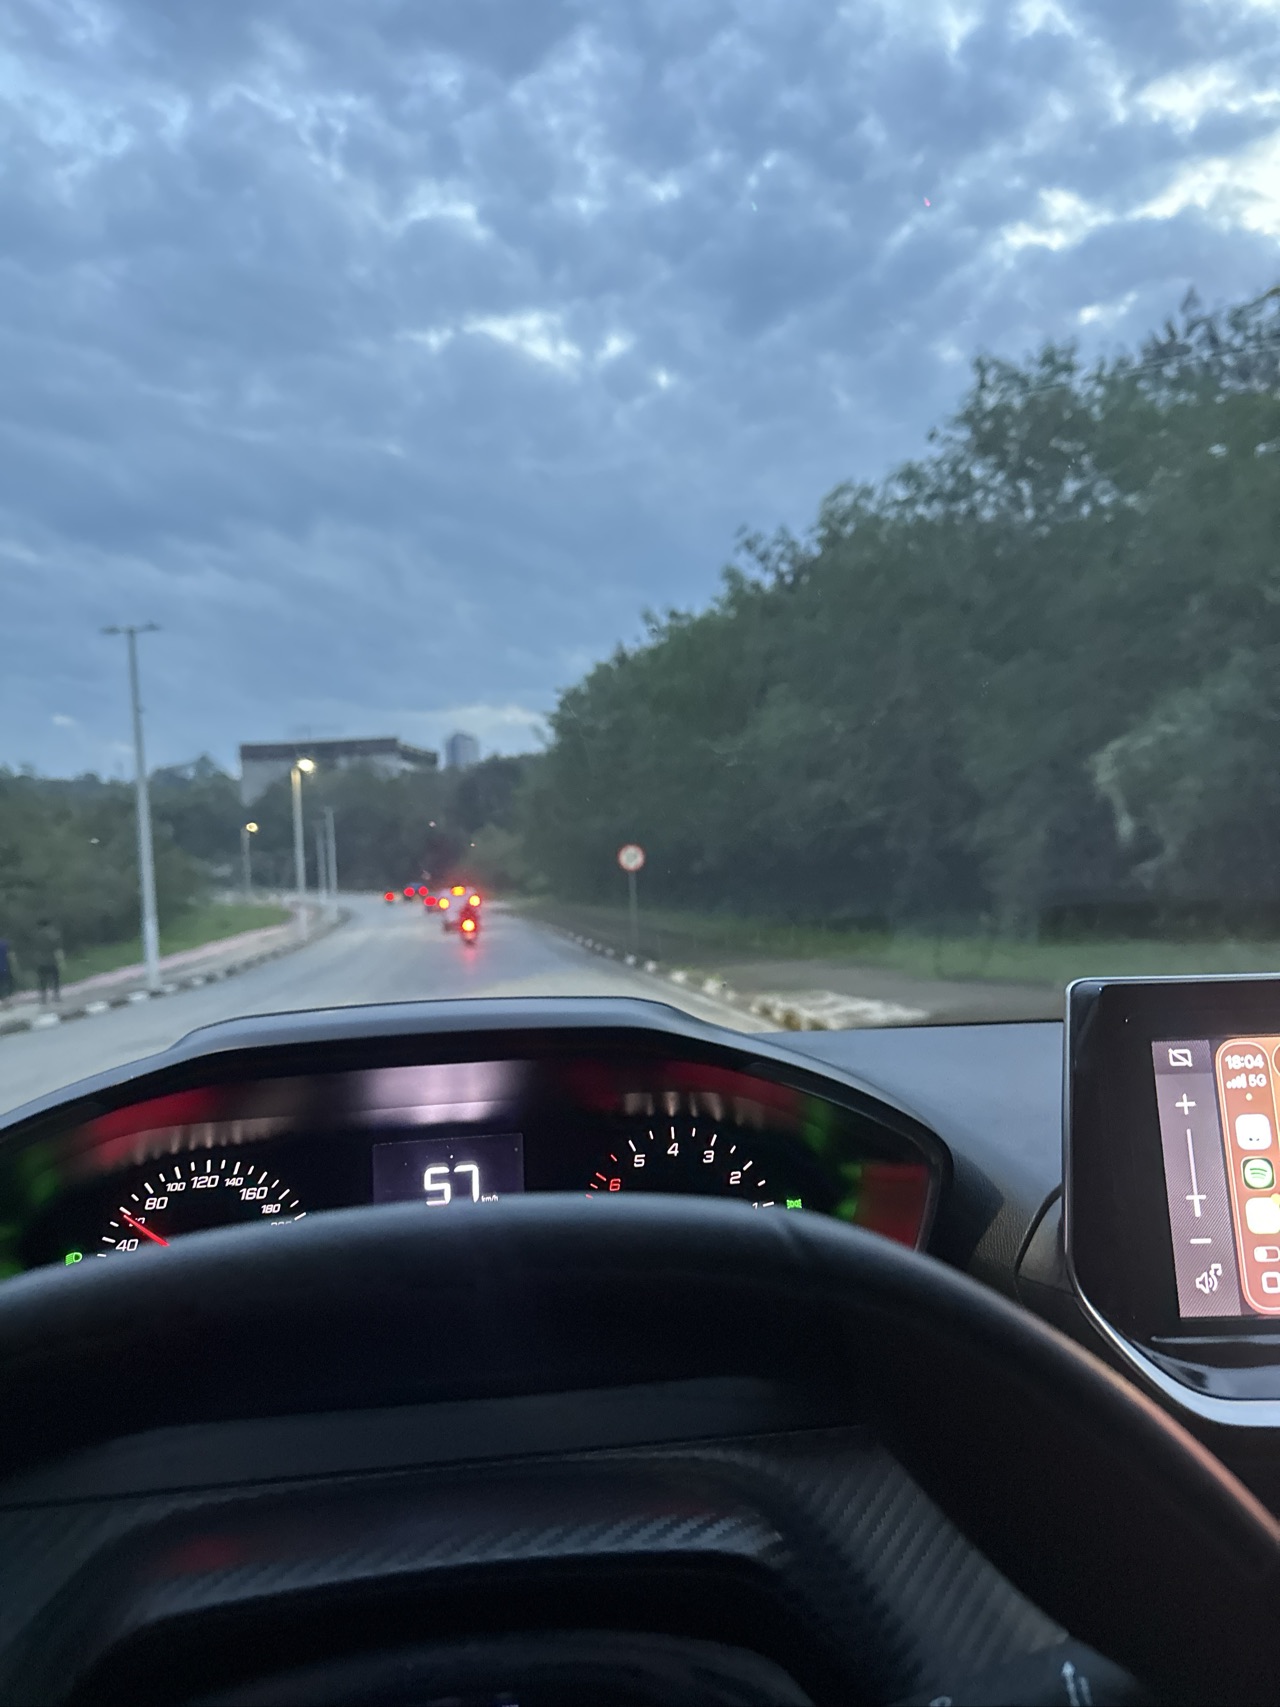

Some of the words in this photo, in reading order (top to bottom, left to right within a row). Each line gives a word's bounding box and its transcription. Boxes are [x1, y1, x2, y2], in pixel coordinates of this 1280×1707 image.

[1225, 1054, 1264, 1069] 18:04
[1248, 1074, 1267, 1087] 5G
[667, 1142, 679, 1157] 4
[633, 1154, 646, 1168] 5
[702, 1150, 715, 1164] 3
[191, 1175, 219, 1189] 120
[224, 1177, 244, 1187] 140
[424, 1164, 480, 1206] 57
[609, 1178, 621, 1191] 6
[729, 1171, 741, 1185] 2
[166, 1182, 186, 1192] 100
[239, 1187, 268, 1200] 160
[144, 1197, 168, 1210] 80
[261, 1203, 281, 1214] 180
[115, 1238, 138, 1252] 40
